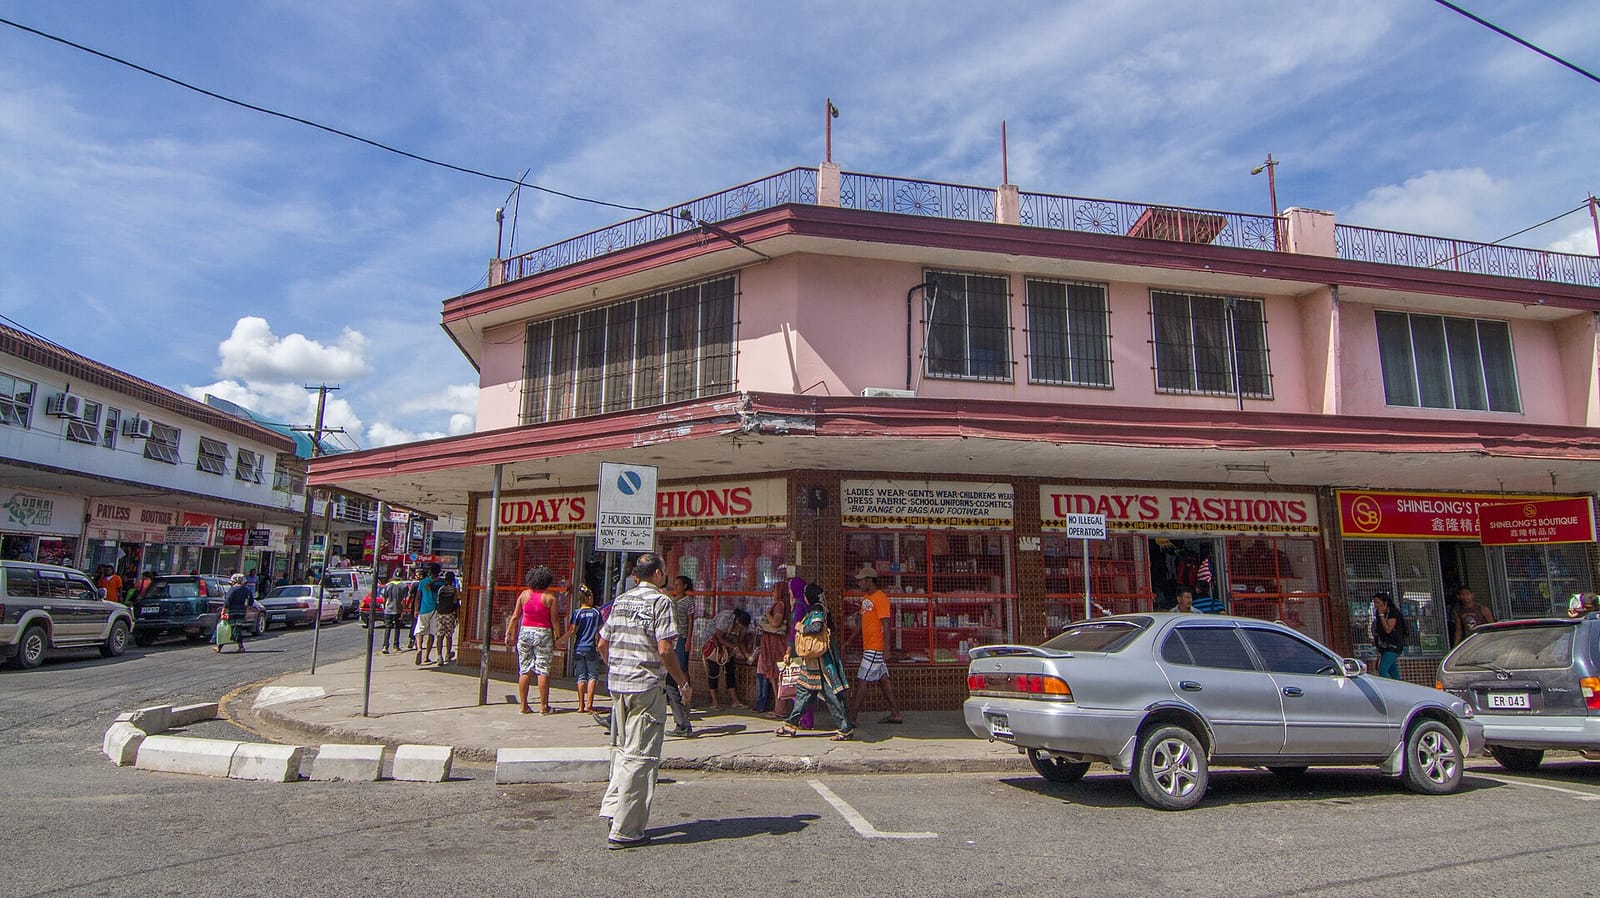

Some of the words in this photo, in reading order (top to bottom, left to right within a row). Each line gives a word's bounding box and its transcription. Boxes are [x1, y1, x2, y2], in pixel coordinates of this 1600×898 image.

[846, 488, 874, 496] LADIES
[877, 489, 904, 497] WEAR
[908, 490, 934, 498] GENTS
[501, 497, 585, 524] UDAY'S
[656, 487, 752, 519] HIONS
[851, 505, 865, 513] BIG
[908, 506, 928, 514] BAGS
[947, 508, 989, 516] FOOTWEAR
[976, 501, 1013, 509] COSMETICS
[1051, 494, 1160, 520] UDAY'S
[1170, 497, 1307, 523] FASHIONS
[1397, 499, 1473, 514] SHINELONG'S
[97, 503, 131, 520] PAYLESS
[141, 509, 173, 525] BOUTIQUE
[600, 514, 606, 524] 2
[608, 515, 631, 525] HOURS
[632, 516, 652, 526] LIMIT
[1068, 515, 1077, 524] NO
[1079, 516, 1103, 525] ILLEGAL
[1490, 519, 1537, 529] SHINELONG'S
[1539, 516, 1578, 526] BOUTIQUE
[1068, 527, 1104, 537] OPERATORS
[602, 537, 615, 546] SAT
[1493, 696, 1505, 707] ER
[1508, 696, 1525, 707] 043
